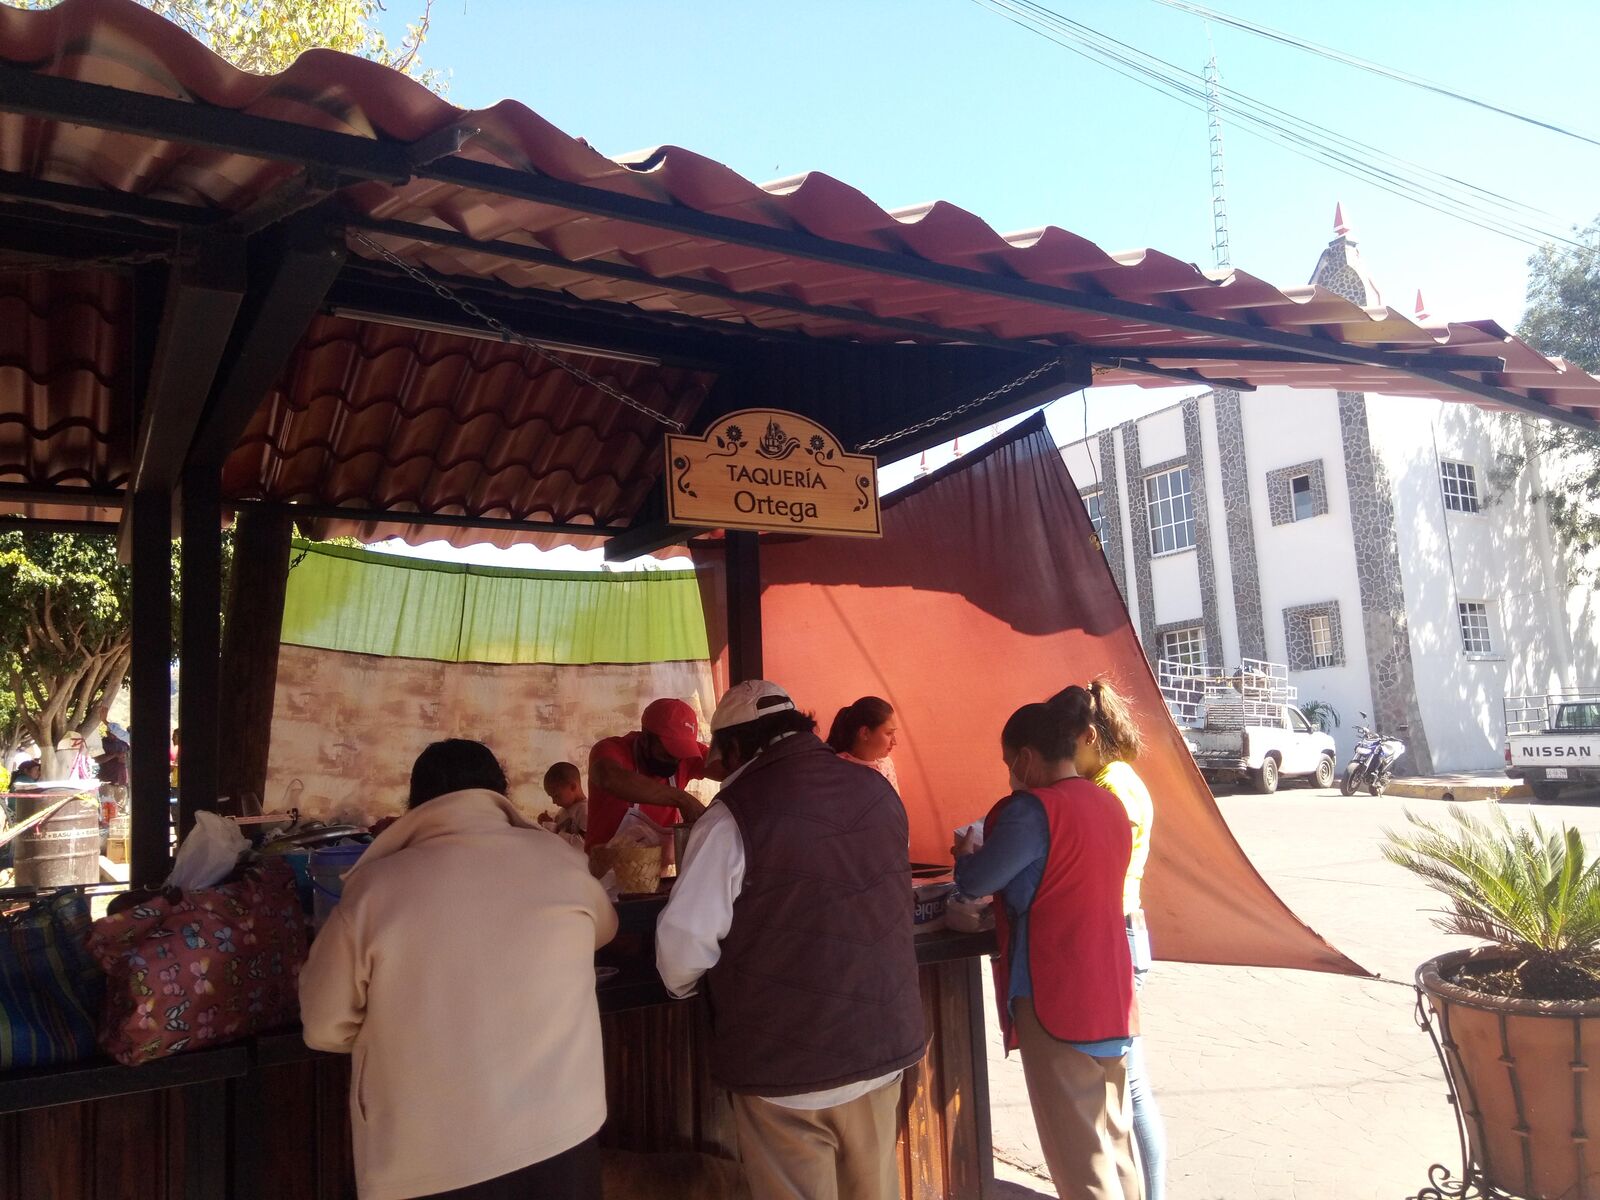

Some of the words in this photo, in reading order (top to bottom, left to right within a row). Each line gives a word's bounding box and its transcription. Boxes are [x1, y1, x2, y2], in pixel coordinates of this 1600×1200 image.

[726, 464, 827, 490] TAQUERÍA
[734, 491, 818, 522] Ortega
[1522, 746, 1591, 757] NISSAN
[52, 831, 80, 839] BASUA
